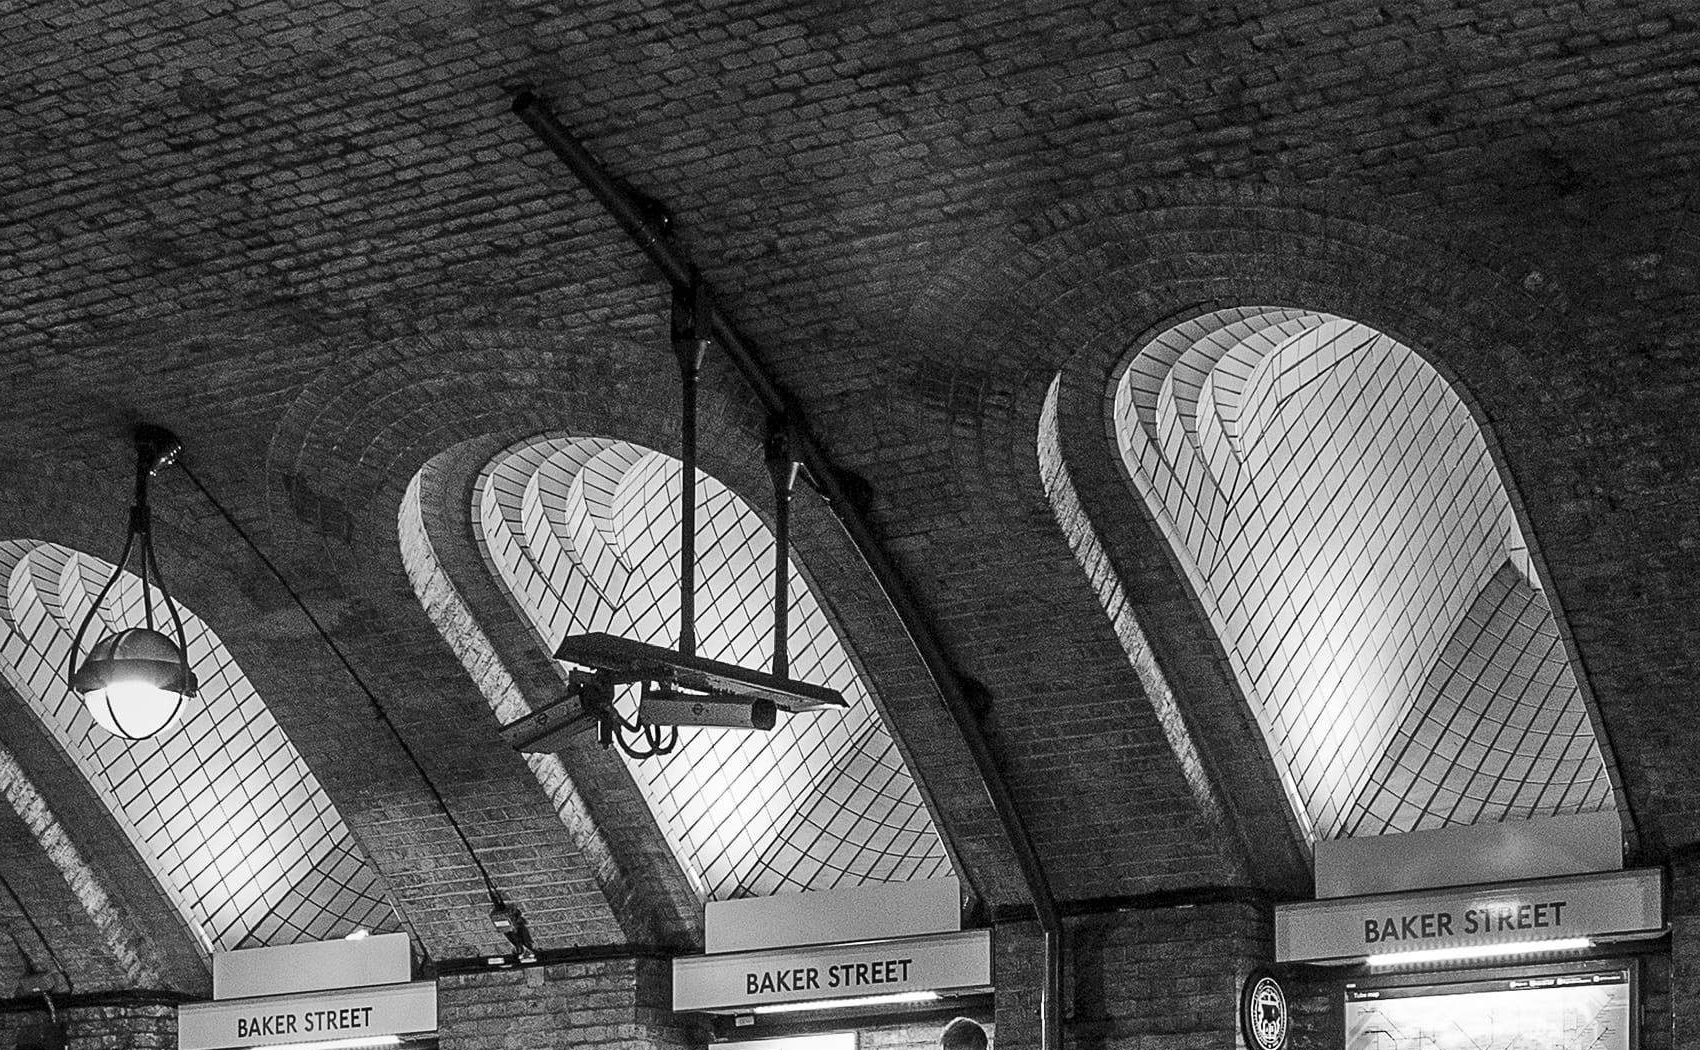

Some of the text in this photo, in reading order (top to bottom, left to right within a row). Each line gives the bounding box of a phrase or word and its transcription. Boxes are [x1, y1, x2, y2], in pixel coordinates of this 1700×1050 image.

[1365, 902, 1566, 943] BAKER STREET
[746, 959, 912, 995] BAKER STREET
[238, 1007, 372, 1038] BAKER STREET
